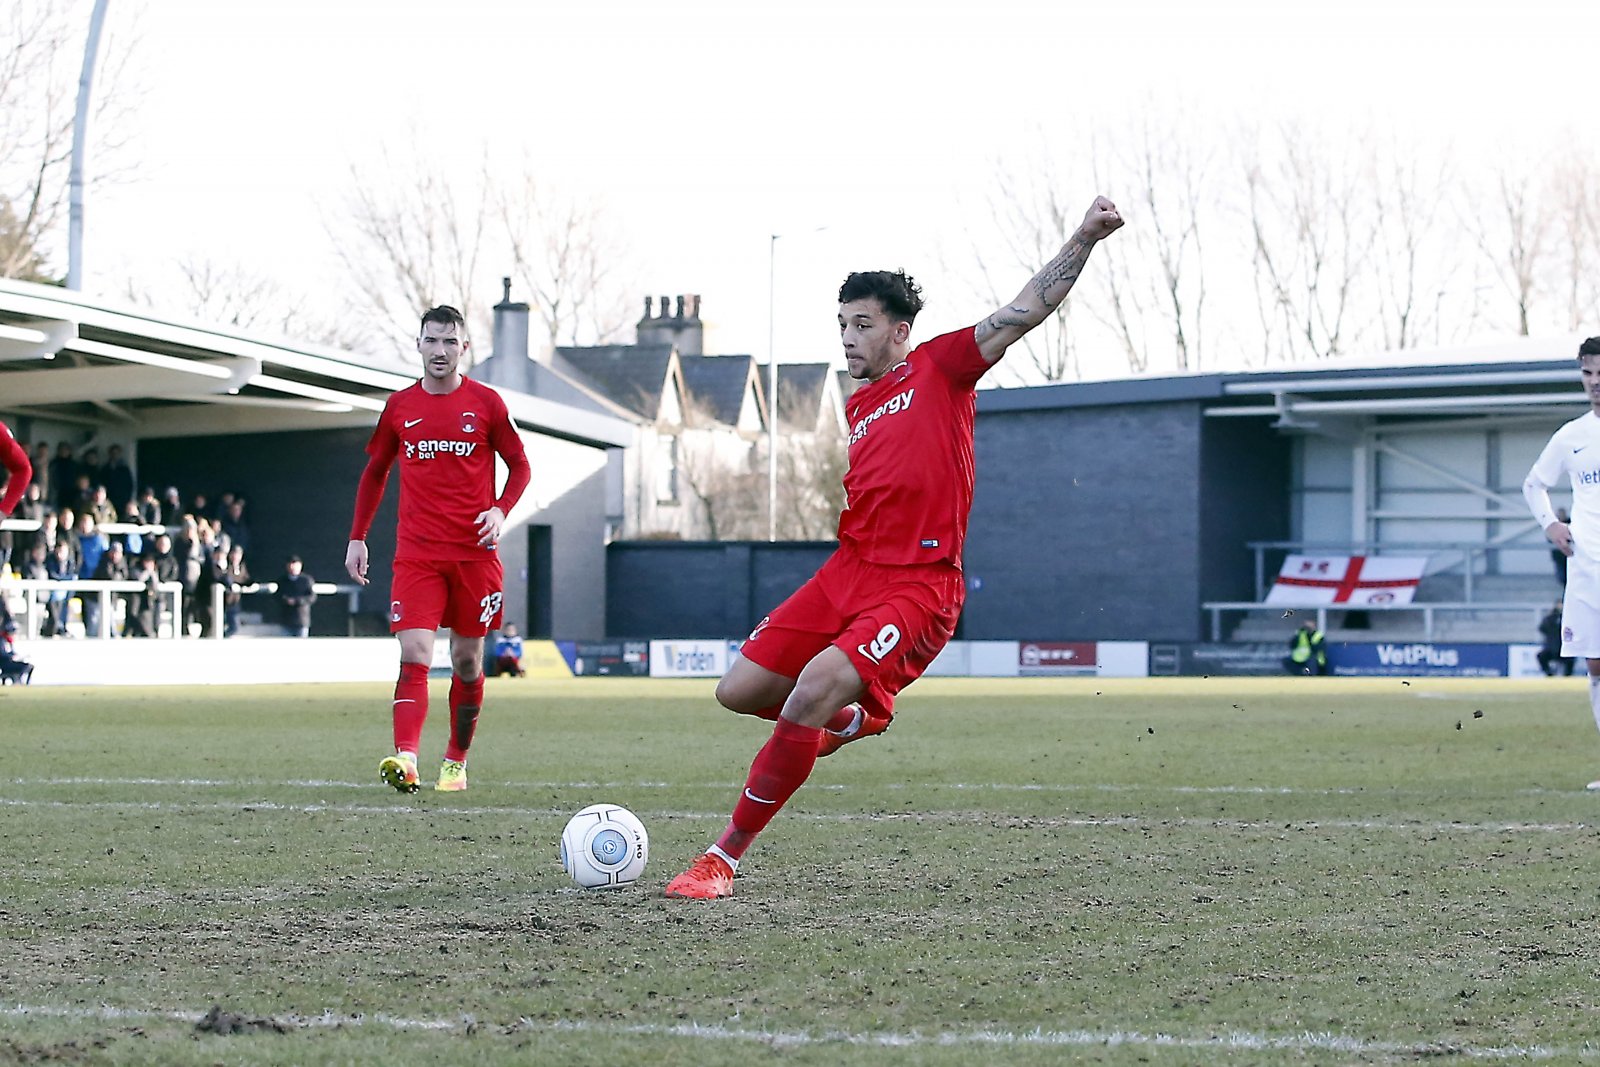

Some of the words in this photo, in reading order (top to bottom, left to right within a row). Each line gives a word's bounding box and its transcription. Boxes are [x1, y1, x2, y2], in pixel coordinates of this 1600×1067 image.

[855, 388, 915, 434] energy
[418, 440, 476, 456] energy
[418, 451, 435, 459] bet
[1577, 470, 1600, 484] Vet
[480, 591, 502, 623] 23
[870, 623, 901, 660] 9
[663, 645, 715, 671] Varden
[1376, 644, 1459, 667] VetPlus
[633, 829, 643, 860] JAKO
